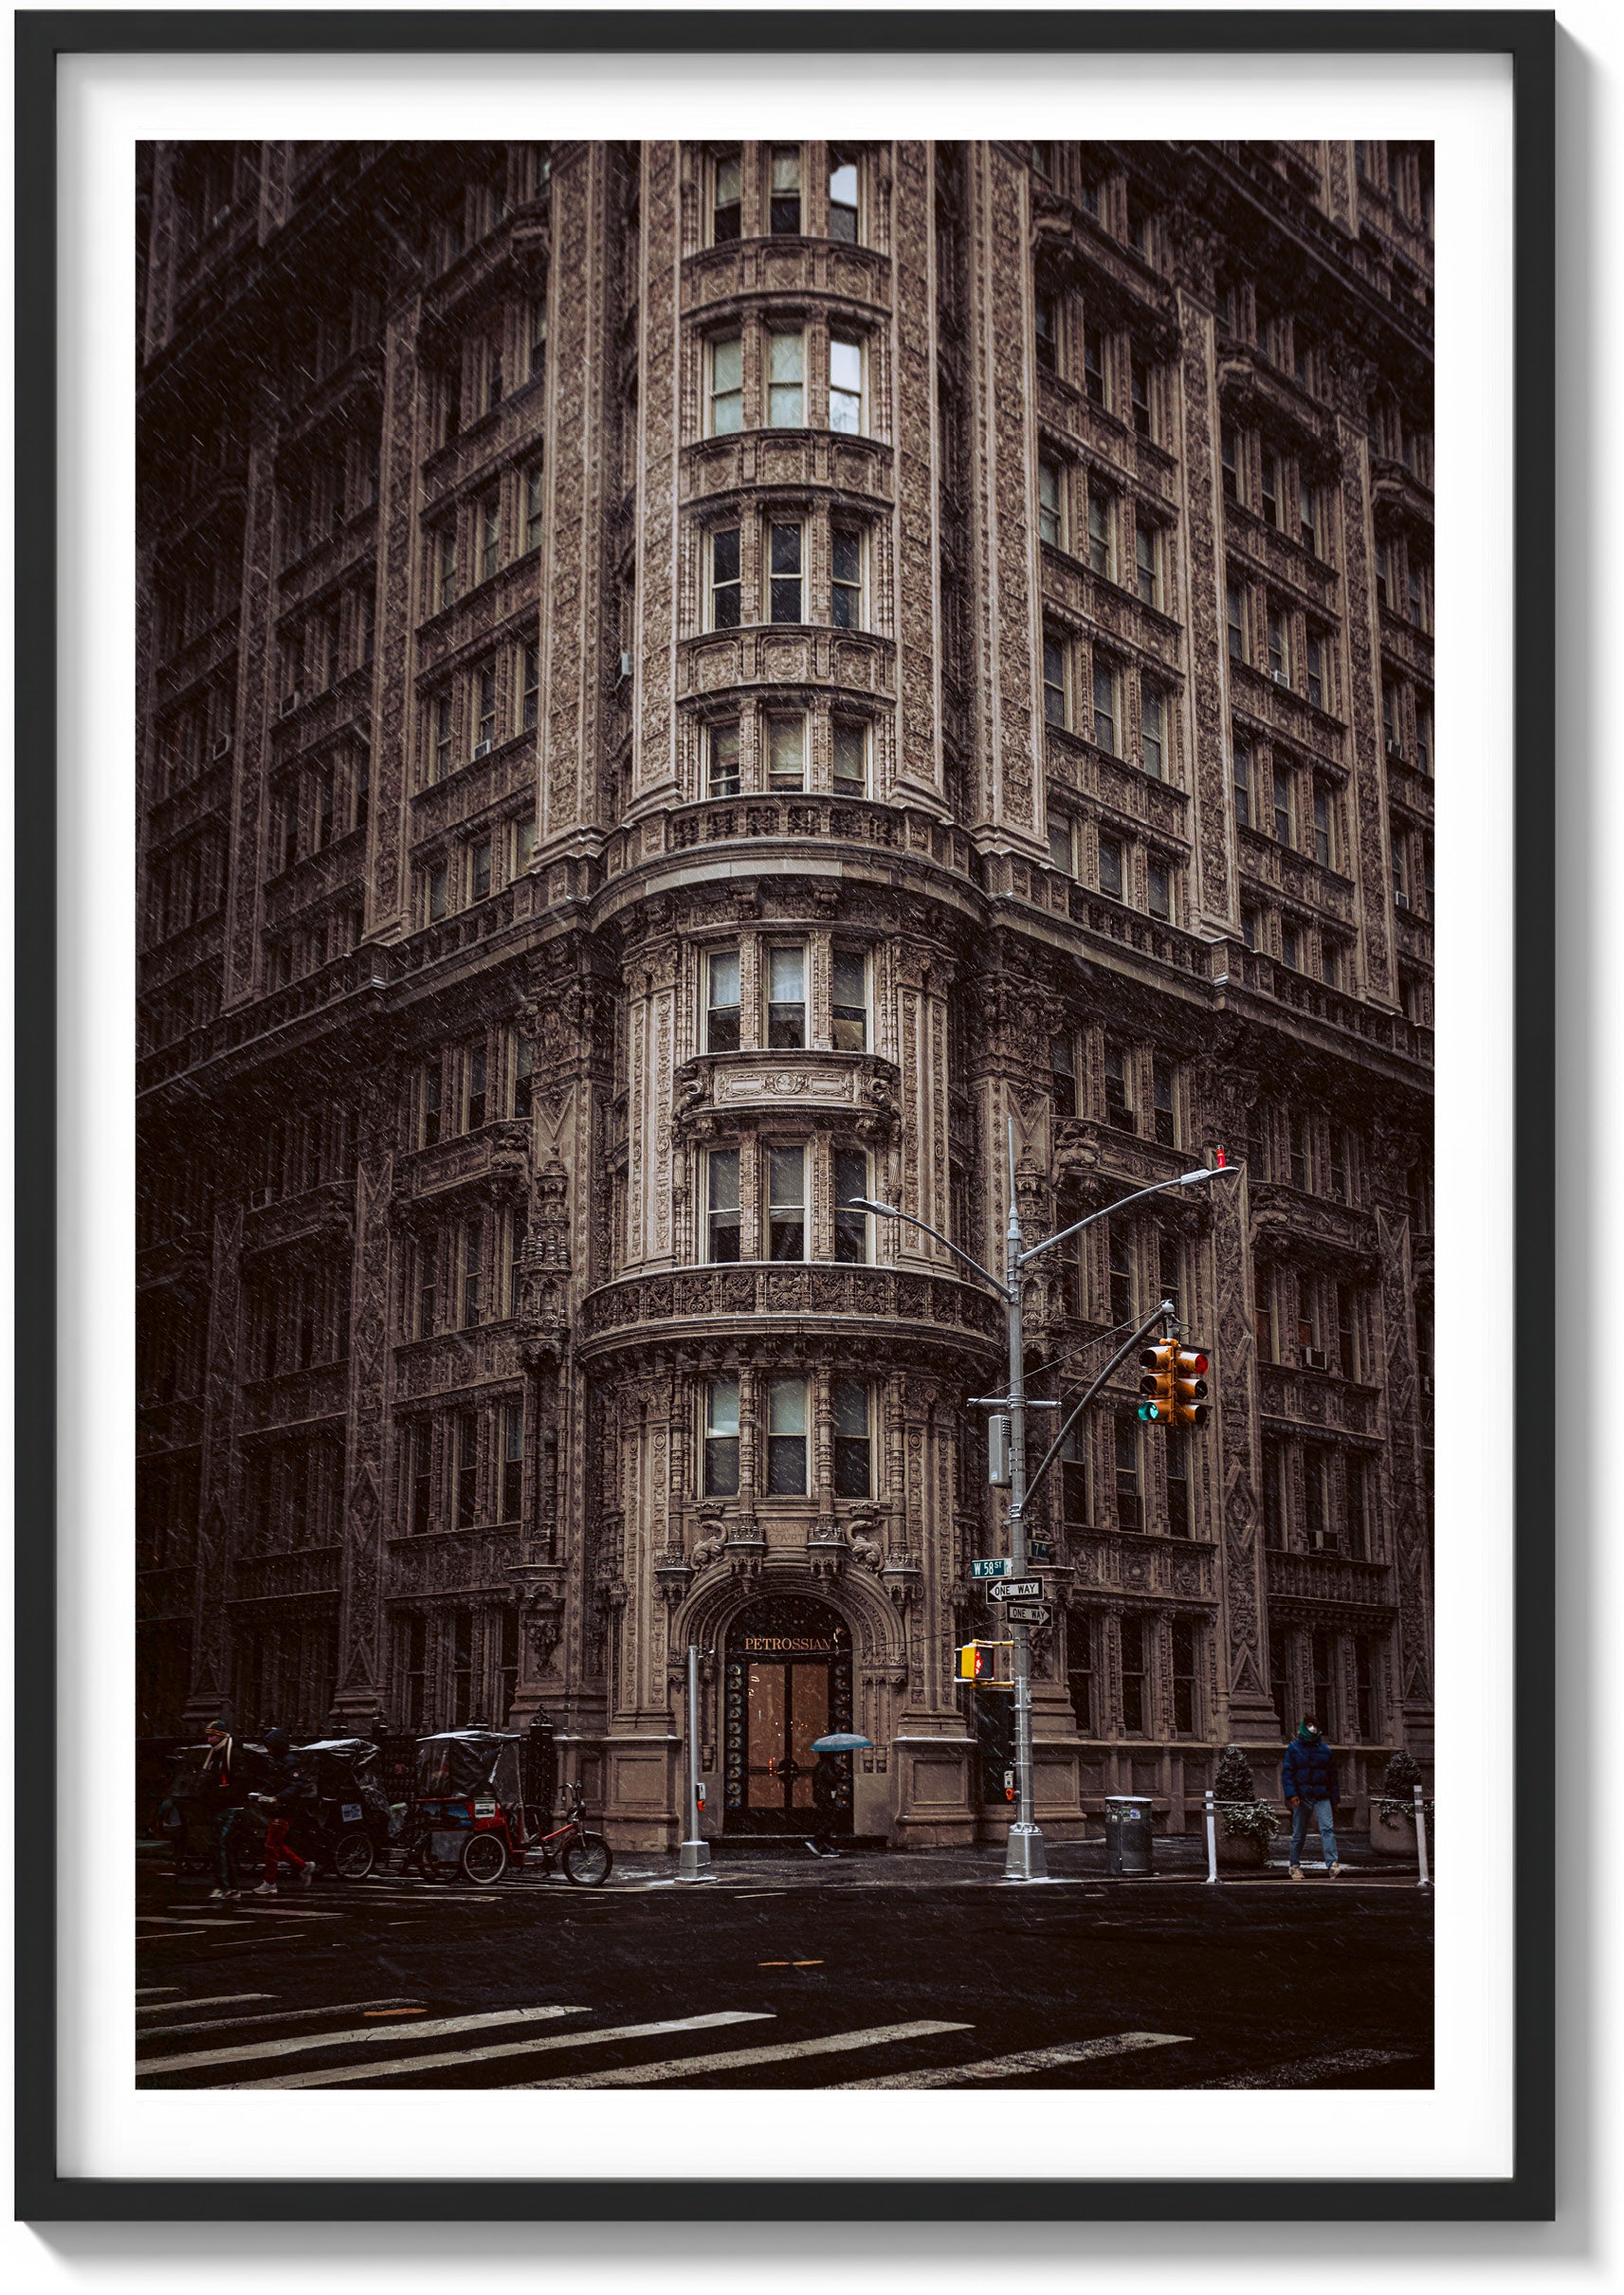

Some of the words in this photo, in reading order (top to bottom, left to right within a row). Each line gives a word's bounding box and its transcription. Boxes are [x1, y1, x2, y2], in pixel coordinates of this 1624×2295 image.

[1034, 1542, 1039, 1556] 7
[974, 1562, 981, 1576] W
[983, 1561, 994, 1576] 58
[994, 1560, 1003, 1569] ST
[994, 1586, 1011, 1596] ONE
[1017, 1584, 1035, 1594] WAY
[1013, 1608, 1026, 1619] ONE
[1031, 1610, 1046, 1620] WAY
[744, 1637, 832, 1650] PETROSSIAN
